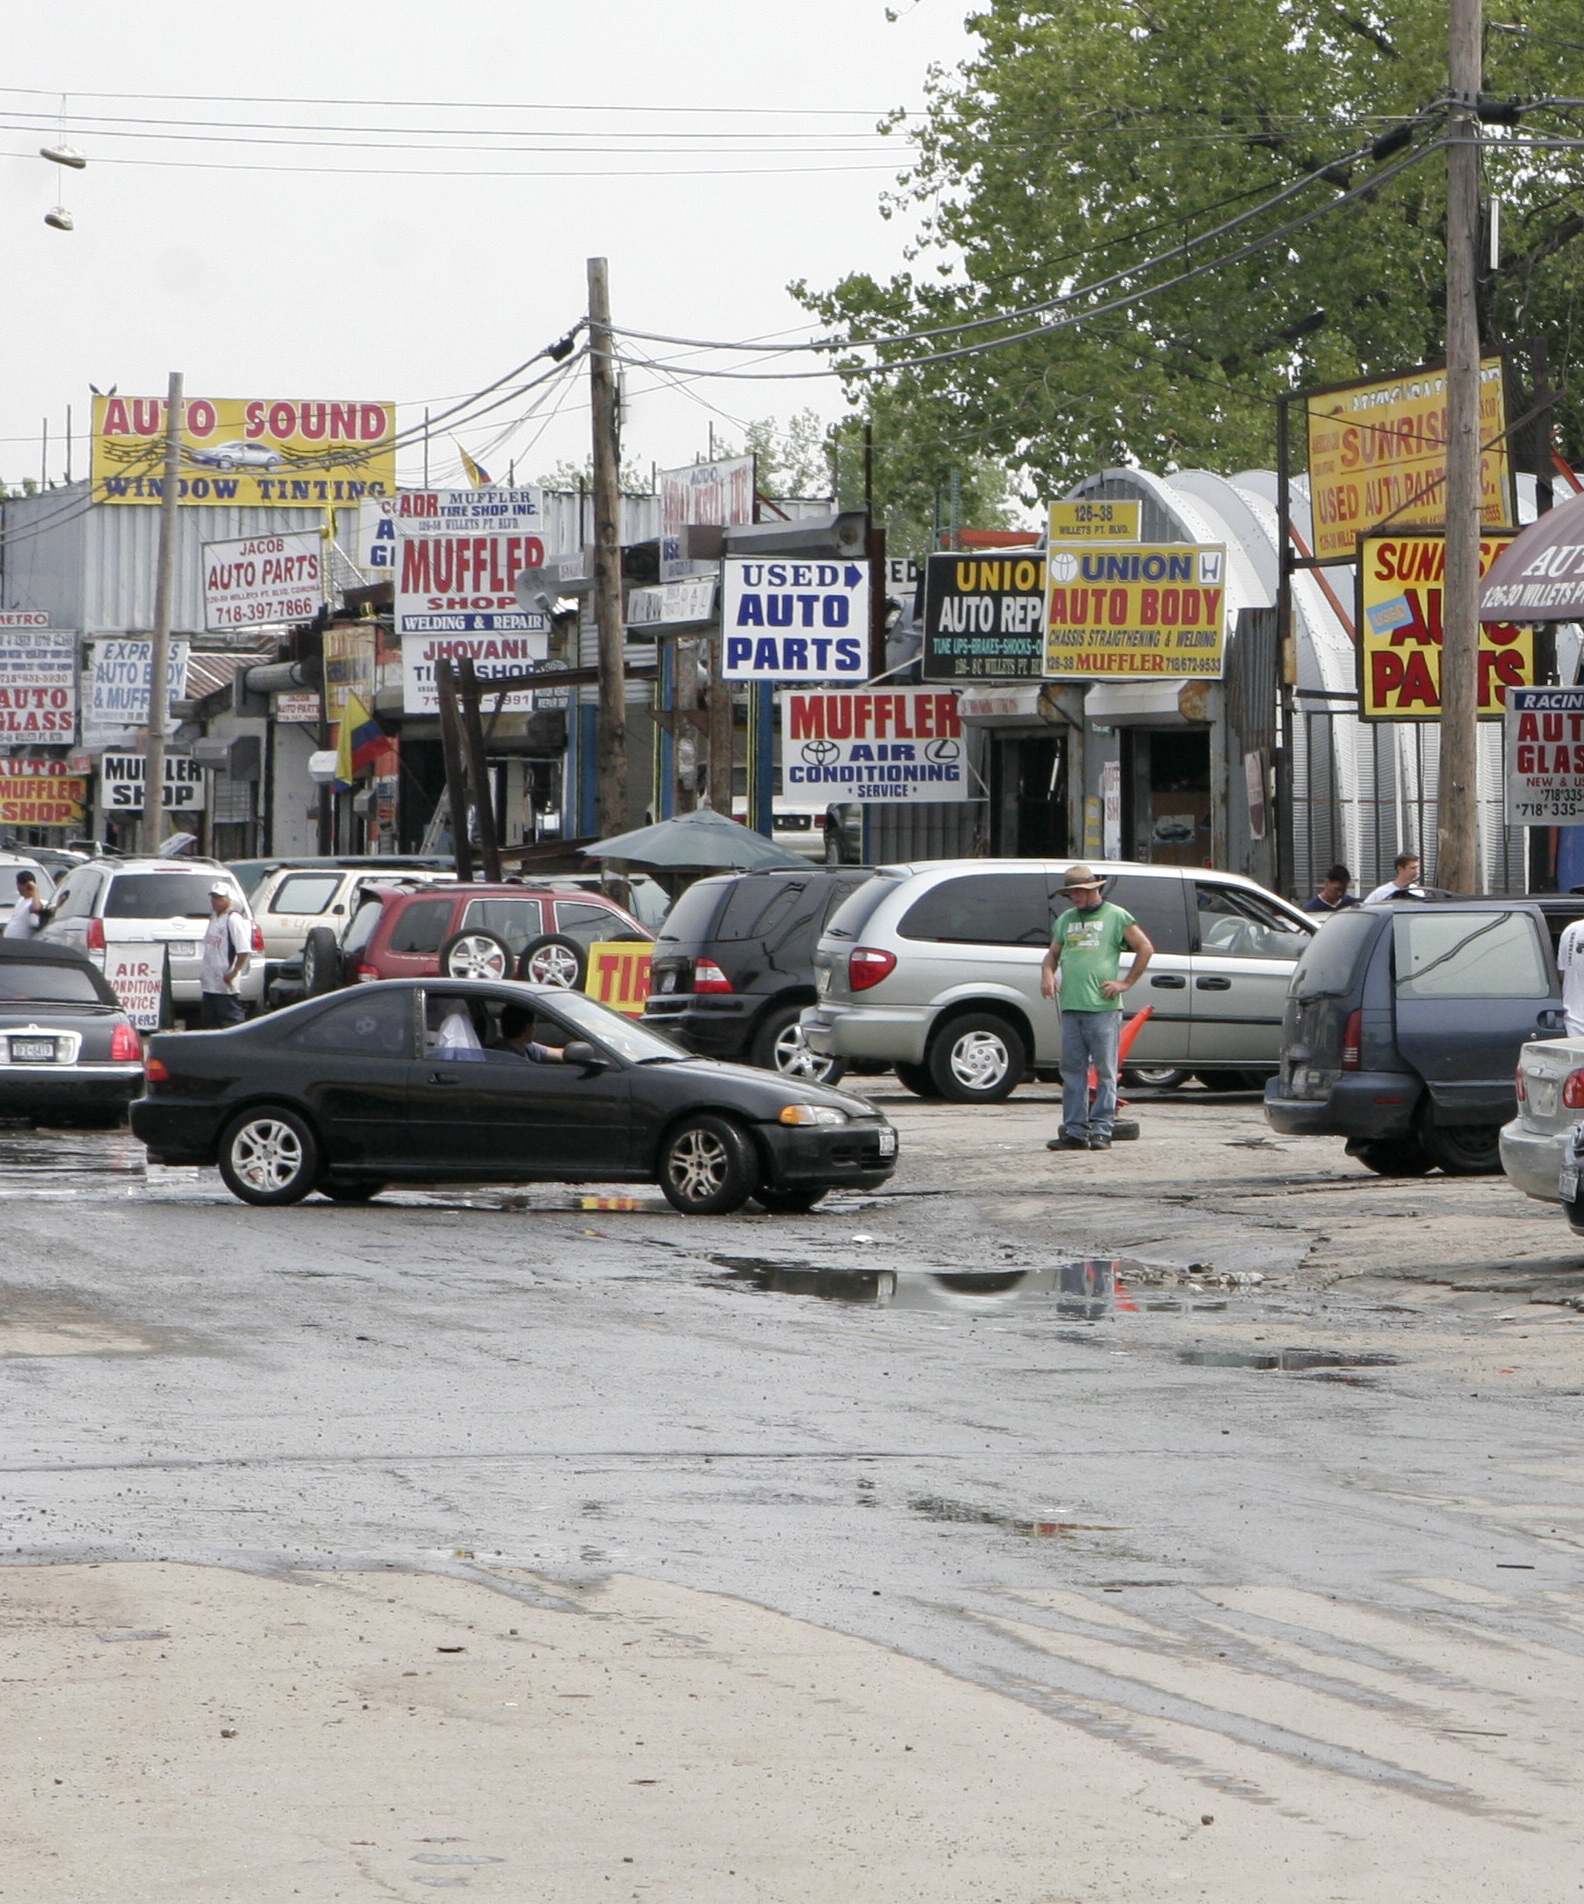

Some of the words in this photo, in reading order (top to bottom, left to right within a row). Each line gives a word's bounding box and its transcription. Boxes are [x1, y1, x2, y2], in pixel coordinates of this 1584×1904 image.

[103, 398, 217, 438] AUO
[245, 401, 387, 441] SOUND
[258, 479, 386, 501] TINTING
[450, 491, 531, 504] MUFFLER
[440, 504, 468, 517] TIRE
[472, 504, 509, 517] SHOP
[513, 504, 540, 517] INC.
[1318, 484, 1359, 526] USED
[1365, 475, 1400, 517] AUTO
[1074, 505, 1113, 521] 126-38
[445, 519, 479, 531] WILLETS
[1059, 525, 1091, 535] WILLETS
[1109, 525, 1130, 534] BLVD.
[240, 538, 284, 556] JACOB
[208, 561, 256, 591] AUTO
[262, 554, 318, 585] PARTS
[741, 564, 839, 588] USED
[1082, 552, 1193, 583] UNION
[427, 597, 518, 610] SHOP
[1481, 584, 1524, 609] 126-30
[1520, 581, 1577, 607] WILLETS
[216, 597, 312, 624] 718-397-7866
[737, 594, 850, 627] AUTO
[939, 597, 994, 633] AUTO
[1050, 588, 1128, 625] AUTO
[1140, 588, 1222, 625] BODY
[404, 615, 466, 631] WELDING
[473, 615, 485, 629] &
[493, 614, 543, 629] REPAIR
[1049, 629, 1086, 647] CHASSIS
[1164, 630, 1172, 647] &
[1176, 630, 1218, 648] WELDING
[103, 643, 180, 661] EXPRS
[423, 639, 529, 661] JHOVANI
[727, 637, 862, 671] PARTS
[1076, 653, 1164, 672] MUFFLER
[95, 662, 137, 684] AUTO
[94, 688, 104, 709] &
[790, 694, 962, 740] MUFFLER
[849, 744, 916, 761] AIR
[105, 757, 202, 782] MULER
[789, 765, 960, 783] CONDITIONING
[0, 780, 82, 800] MUFFLER
[858, 784, 908, 797] SERVICE
[1526, 777, 1553, 787] NEW
[1559, 777, 1567, 787] &
[2, 802, 72, 822] SHOP
